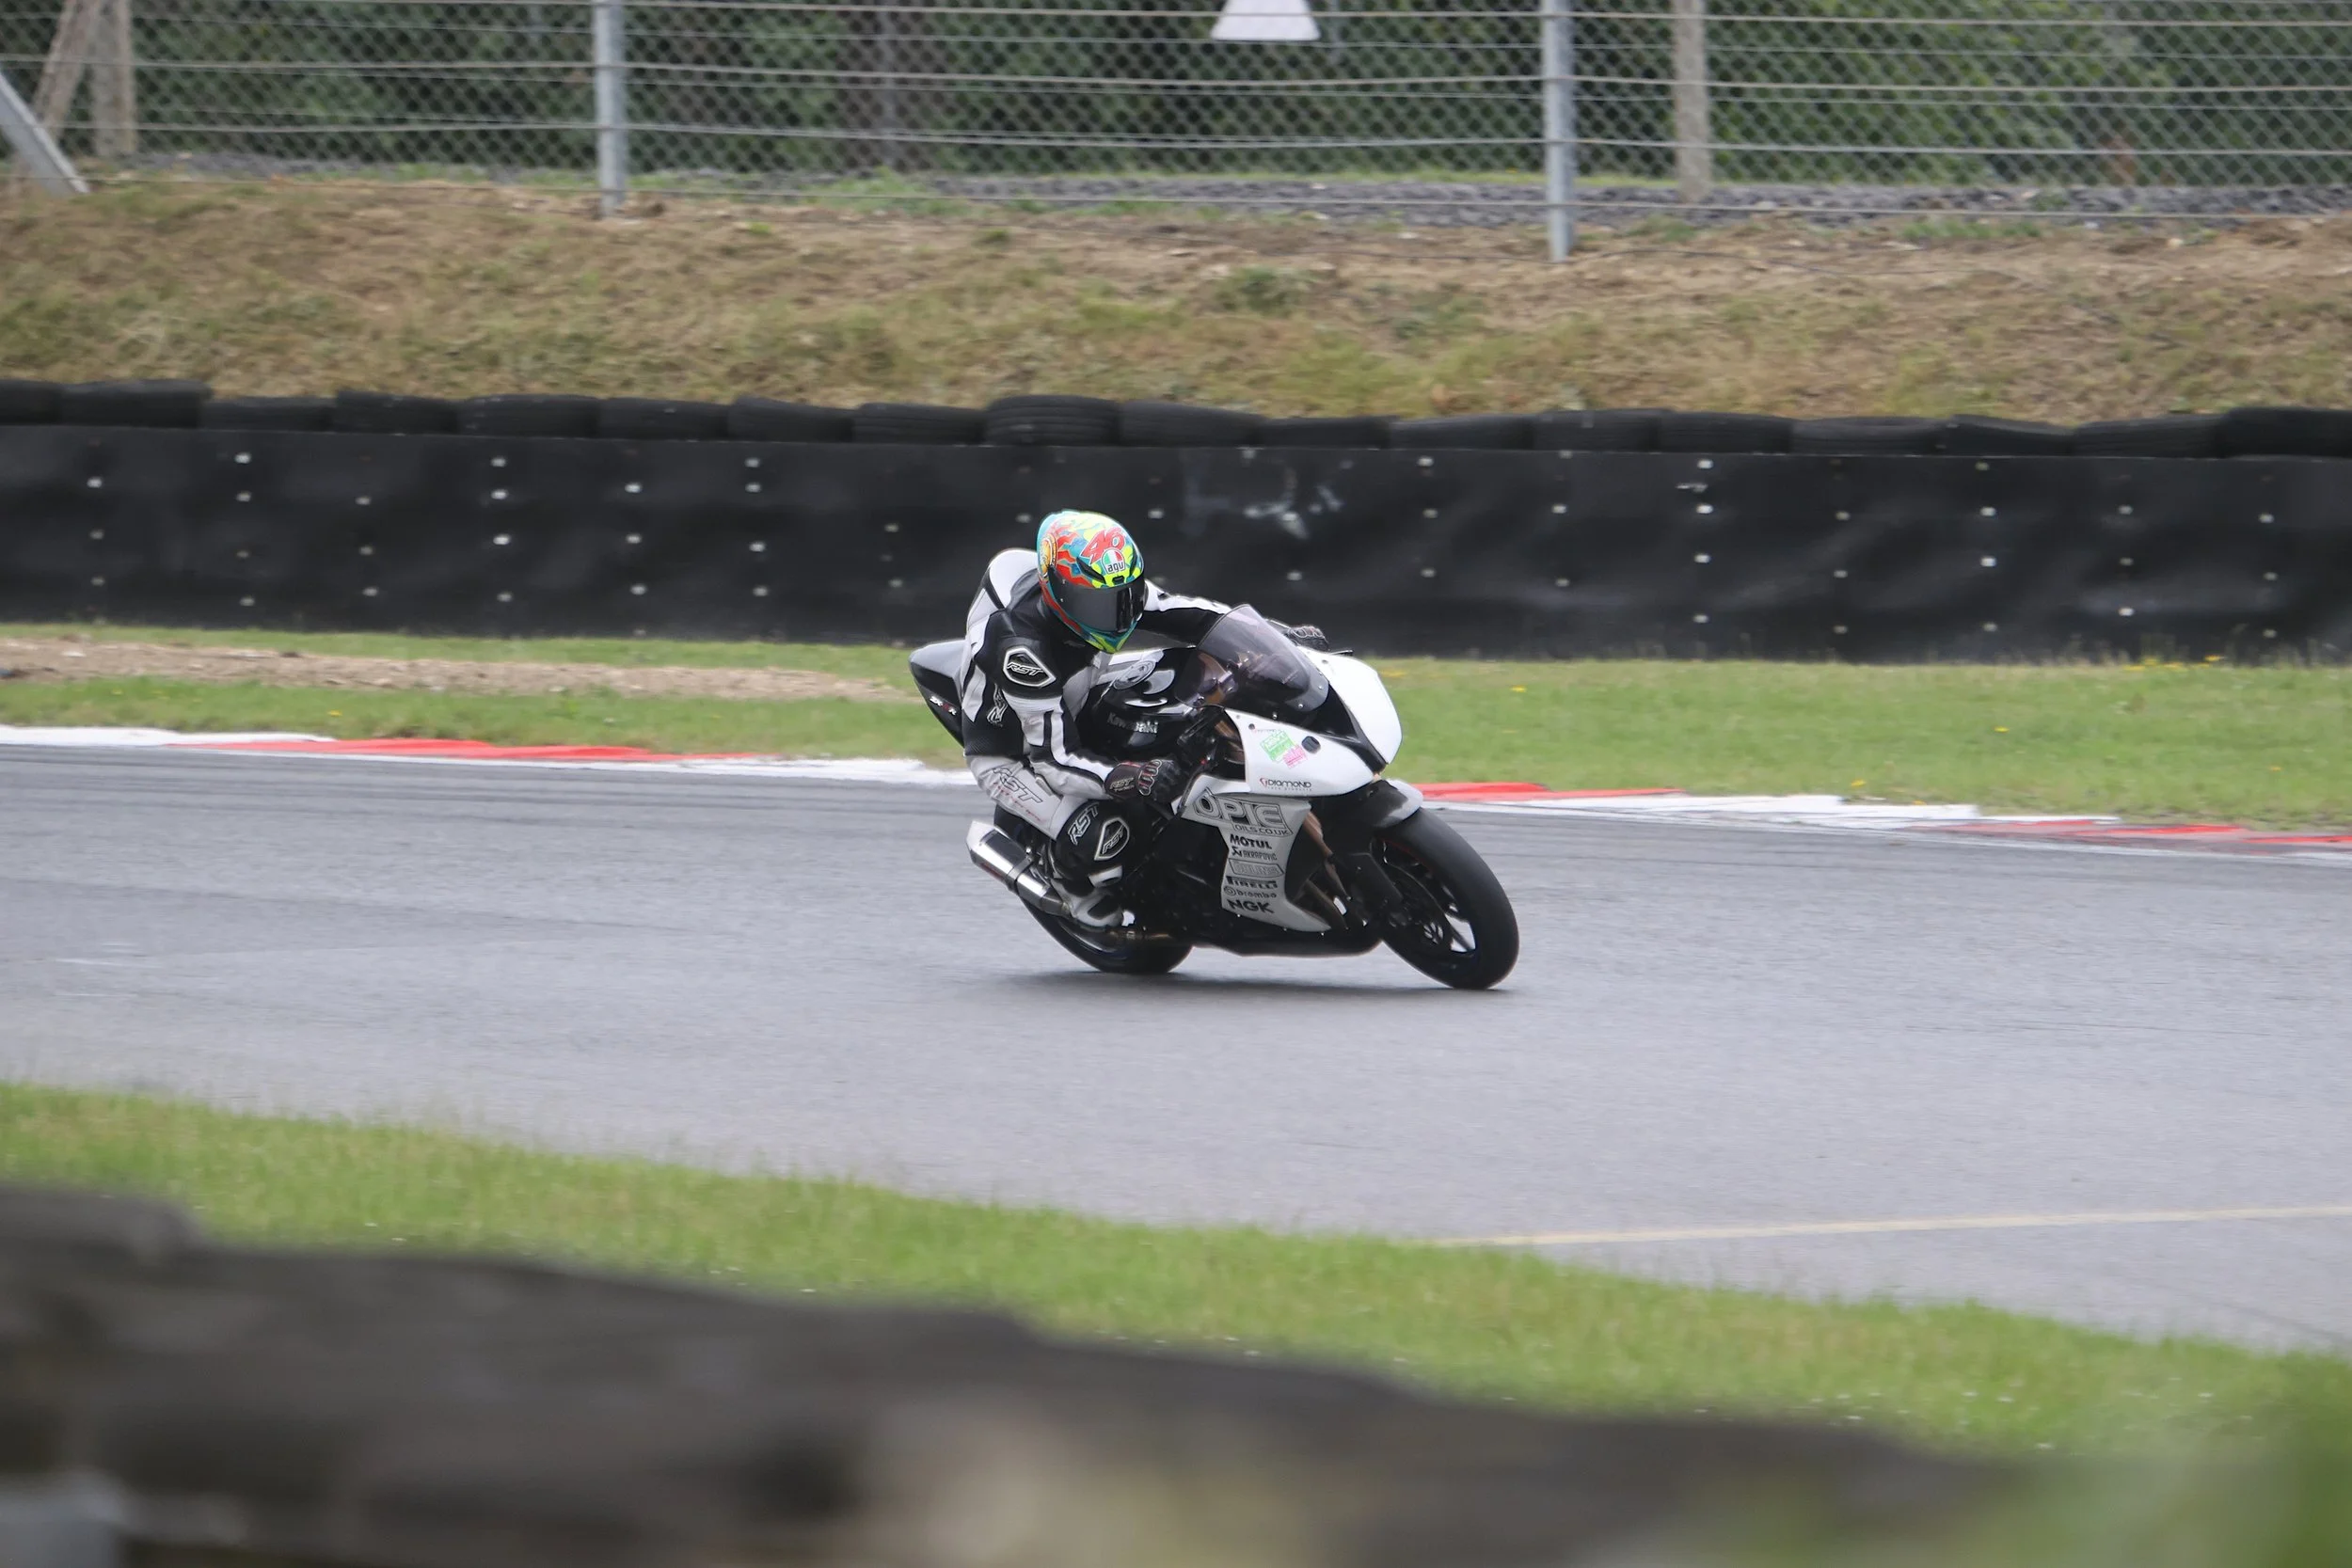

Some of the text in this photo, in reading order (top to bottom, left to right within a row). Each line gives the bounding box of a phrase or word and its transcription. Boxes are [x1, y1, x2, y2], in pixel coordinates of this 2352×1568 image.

[1081, 527, 1126, 566] 46
[1107, 562, 1124, 573] agv
[1007, 661, 1044, 676] RST
[993, 767, 1043, 803] RST
[1193, 788, 1287, 830] OPIE
[1067, 801, 1101, 846] RST
[1102, 826, 1125, 855] RST
[1230, 833, 1272, 849] MOTUL
[1226, 876, 1278, 889] PIRELLI
[1236, 889, 1277, 898] brembo
[1227, 898, 1275, 913] NGK
